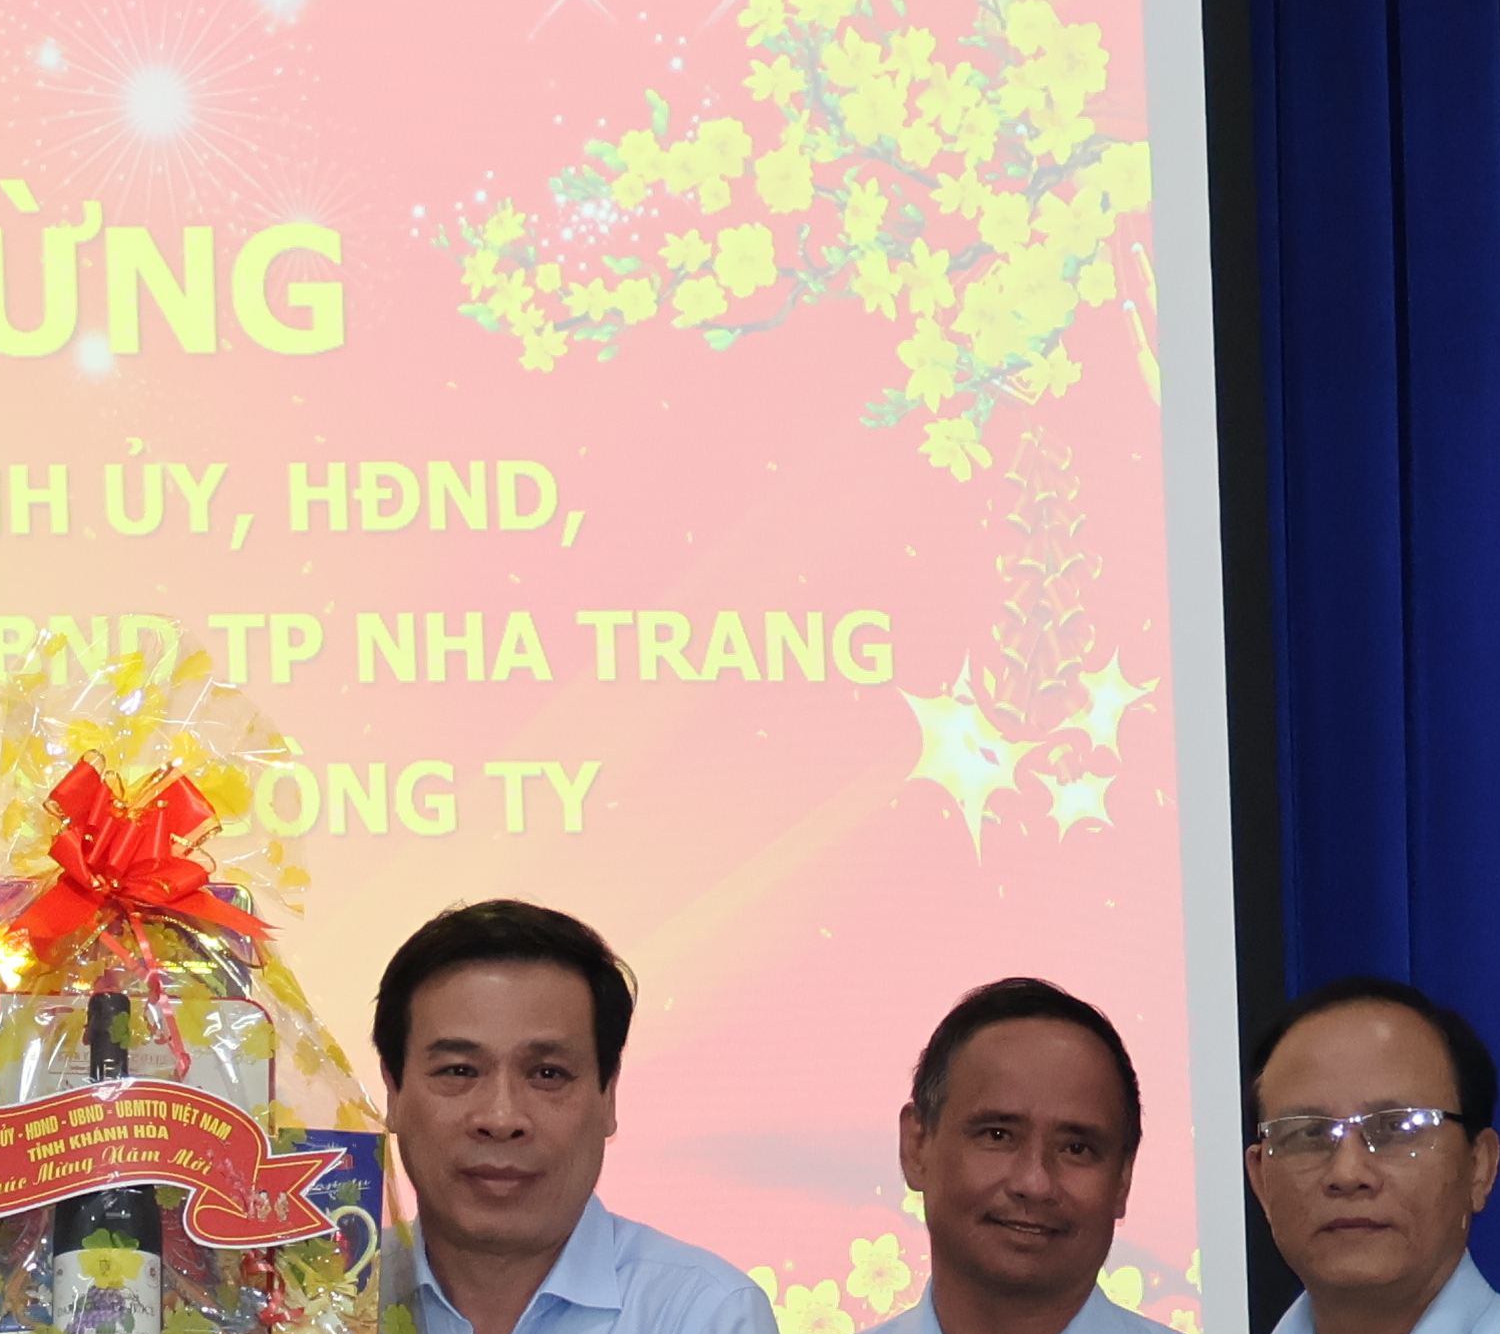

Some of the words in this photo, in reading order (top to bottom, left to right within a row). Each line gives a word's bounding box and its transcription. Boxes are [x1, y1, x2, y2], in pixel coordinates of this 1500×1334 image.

[105, 437, 252, 550] ỦY,
[289, 461, 584, 548] HĐND,
[208, 613, 323, 684] TP
[357, 612, 552, 682] NHA
[577, 610, 894, 685] TRANG
[485, 760, 601, 833] TY
[69, 1125, 129, 1150] KHÁNH
[114, 1099, 168, 1121] UBMTTQ
[199, 1112, 232, 1142] NAM
